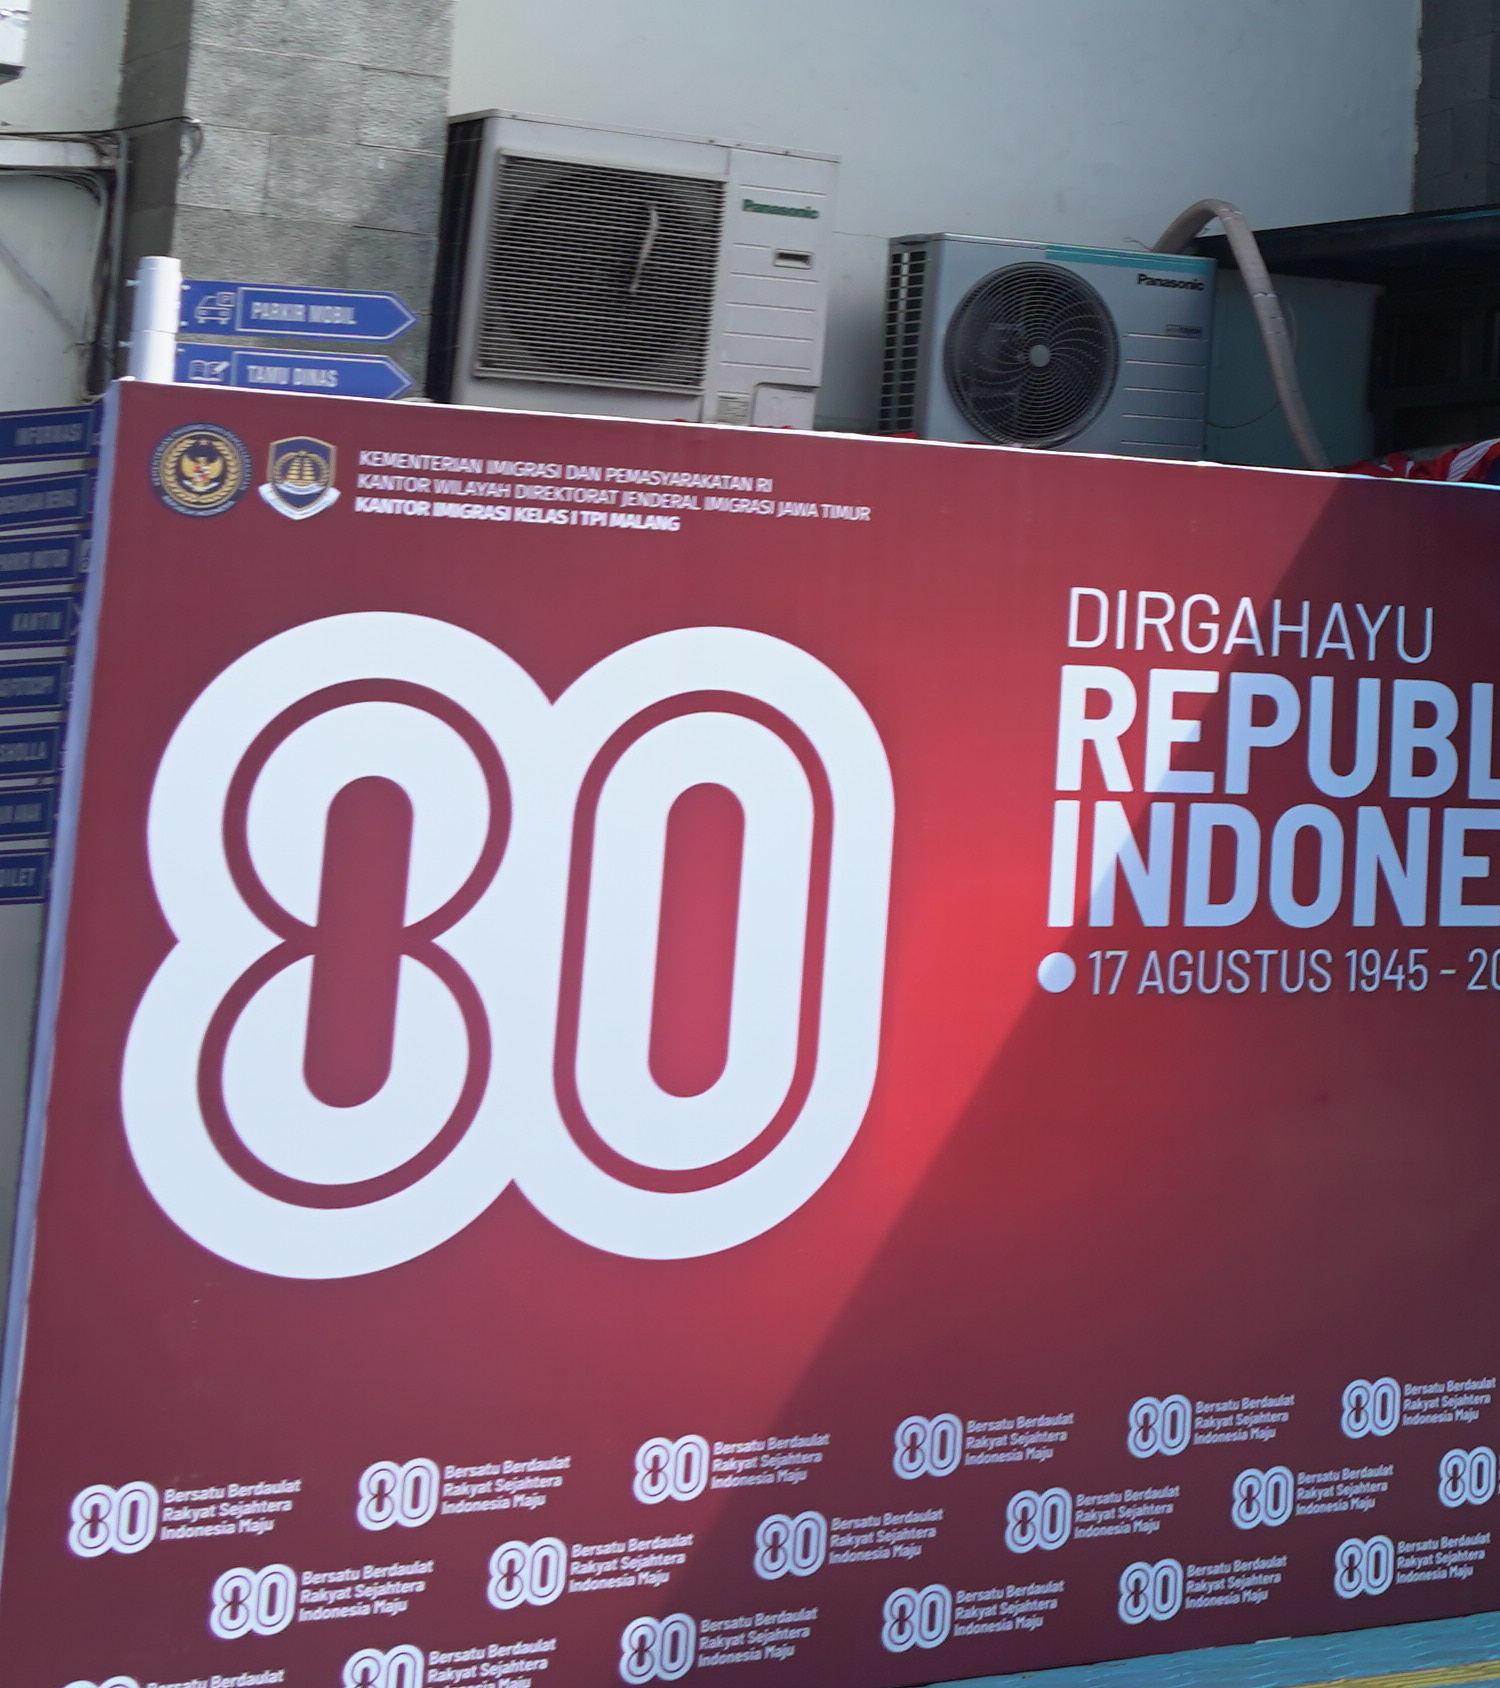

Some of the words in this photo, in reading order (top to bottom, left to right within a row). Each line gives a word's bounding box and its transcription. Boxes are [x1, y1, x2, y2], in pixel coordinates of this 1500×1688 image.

[742, 198, 819, 220] Panasonic
[1137, 273, 1205, 291] Panasonic
[250, 301, 306, 322] PARKIR
[308, 304, 357, 325] MOBIL
[246, 365, 290, 385] TAMU
[293, 367, 339, 388] DINAS
[359, 450, 484, 474] KEMENTERIAN
[486, 459, 563, 479] IMIGRASI
[565, 465, 602, 482] DAN
[605, 468, 754, 493] PEMASYARAKATAN
[756, 478, 774, 493] RI
[357, 473, 431, 494] KANTOR
[434, 478, 511, 499] WILAYAH
[514, 484, 619, 505] DIREKTORAT
[621, 491, 702, 511] JENDERAL
[704, 496, 775, 515] IMIGRASI
[776, 500, 819, 518] JAWA
[821, 504, 872, 522] TIMUR
[354, 496, 431, 517] KANTOR
[433, 501, 512, 521] IMIGRASI
[514, 506, 568, 525] KELAS
[570, 510, 578, 526] I
[579, 511, 607, 527] TPI
[609, 512, 681, 532] MALANG
[11, 612, 62, 633] KANTIN
[1067, 587, 1434, 664] DIRGAHAYU
[121, 611, 895, 1279] 80
[1087, 951, 1130, 995] 17
[1137, 948, 1334, 995] AGUSTUS
[1345, 949, 1429, 994] 1945
[164, 1487, 224, 1504] Bersatu
[228, 1479, 301, 1497] Berdaulat
[69, 1481, 159, 1557] 80
[163, 1504, 216, 1523] Rakyat
[219, 1498, 292, 1518] Sejahtera
[160, 1522, 235, 1540] Indonesia
[238, 1517, 275, 1535] Maju
